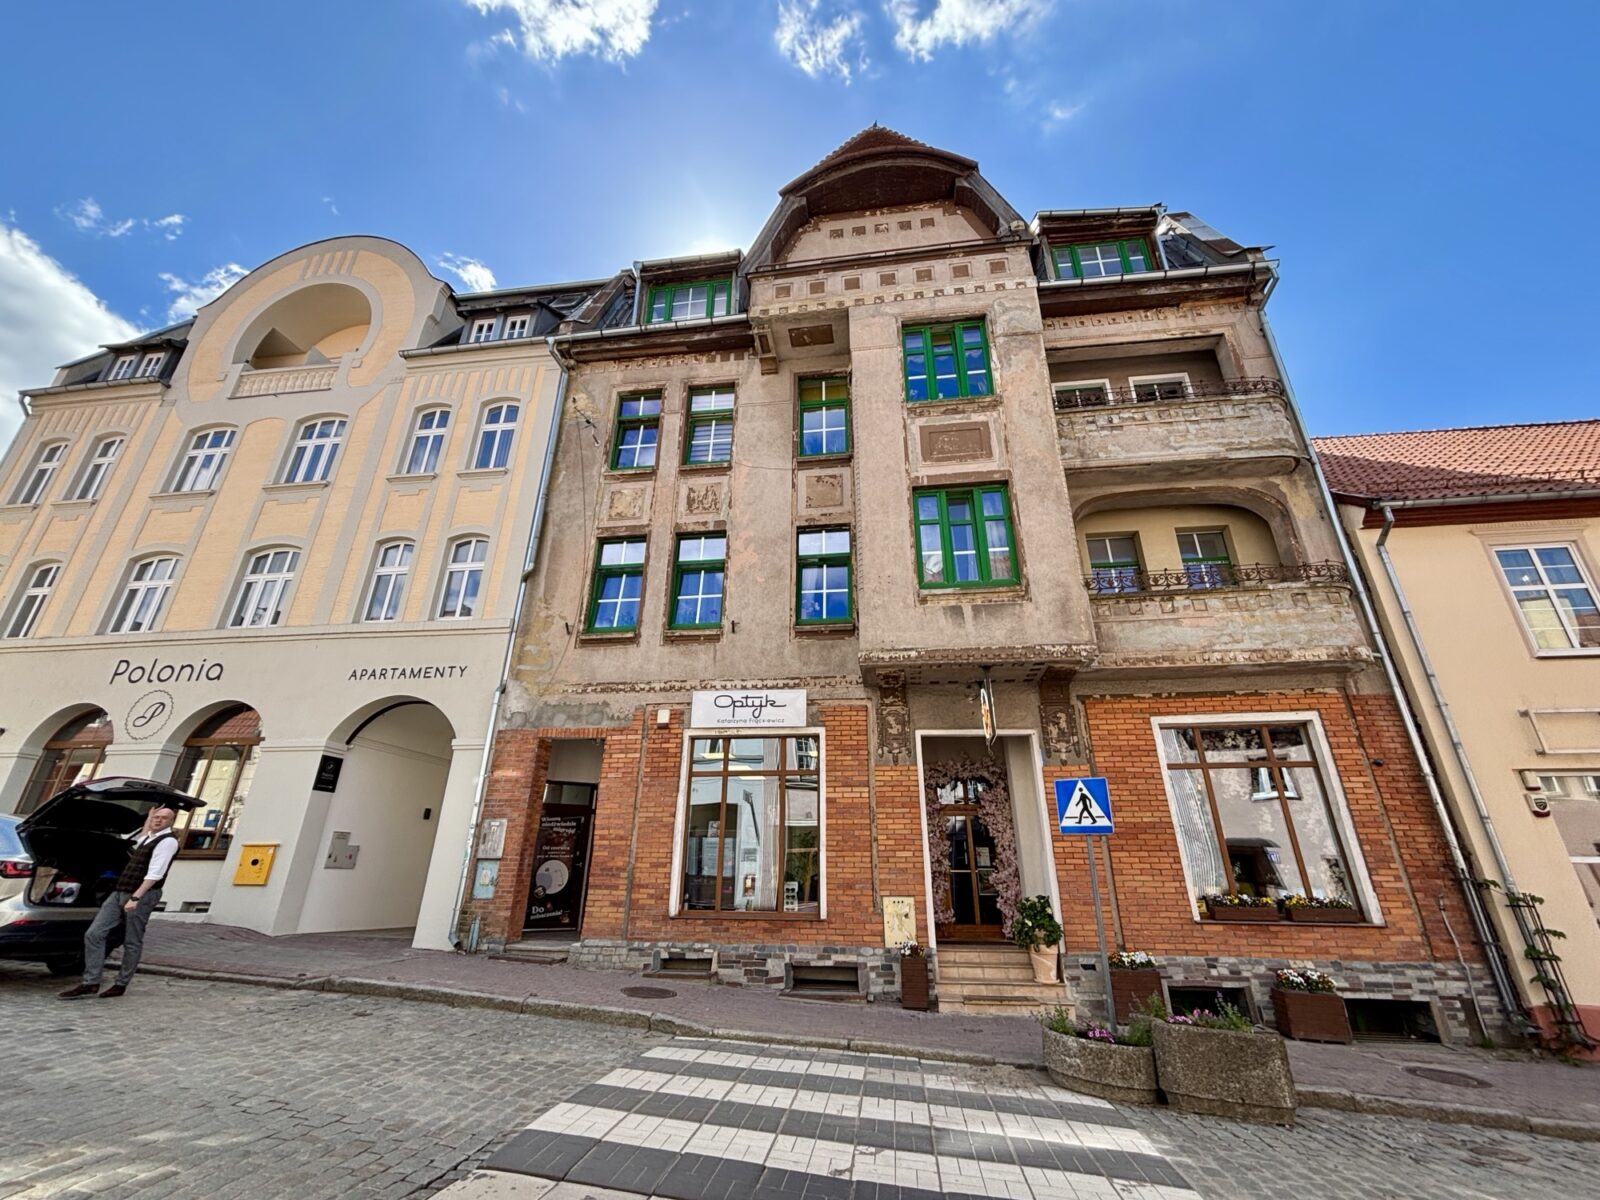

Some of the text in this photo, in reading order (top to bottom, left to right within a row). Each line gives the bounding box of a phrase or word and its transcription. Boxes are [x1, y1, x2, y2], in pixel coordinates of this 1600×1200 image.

[109, 658, 224, 685] Polonia
[348, 665, 468, 681] APARTAMENTY
[714, 694, 787, 718] Optyk
[531, 905, 545, 914] Do
